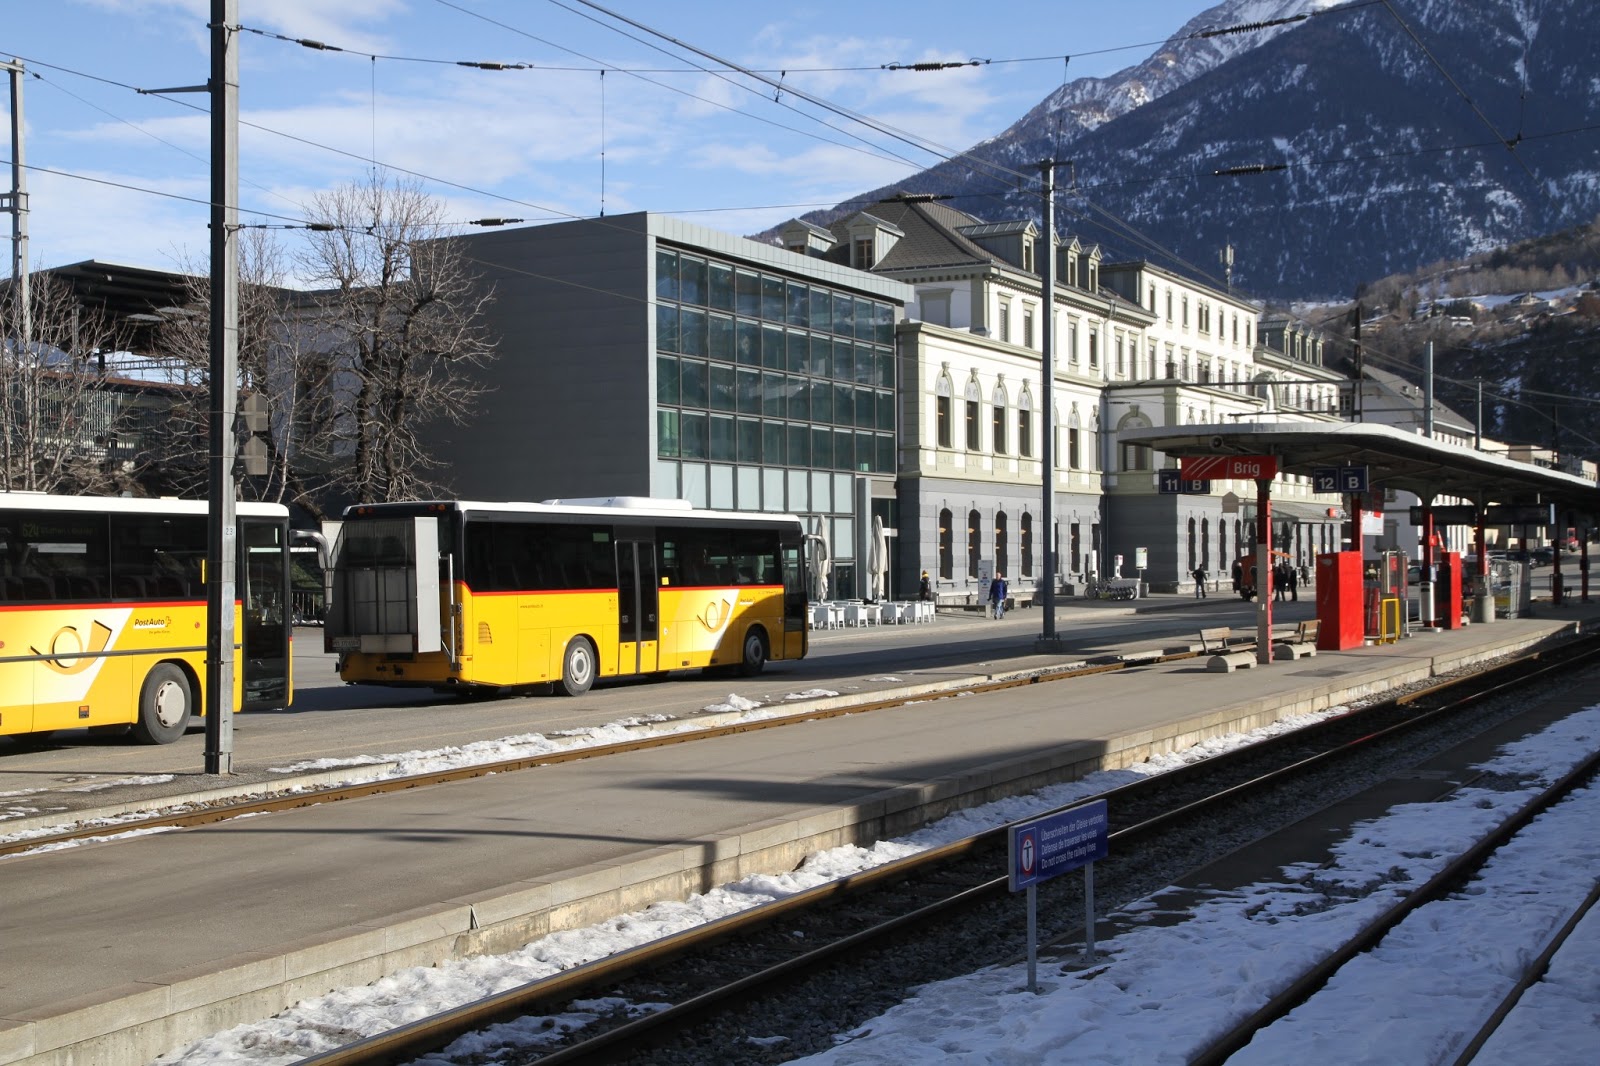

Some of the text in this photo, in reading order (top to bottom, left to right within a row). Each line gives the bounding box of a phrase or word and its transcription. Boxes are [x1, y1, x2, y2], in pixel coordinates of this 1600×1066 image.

[1234, 461, 1261, 476] Brig
[1165, 479, 1202, 491] 11 B
[1318, 476, 1360, 490] 12 B
[134, 618, 165, 627] PostAuto
[1076, 818, 1088, 829] Gleise
[1058, 839, 1064, 849] de
[1064, 835, 1081, 847] traverser
[1088, 829, 1097, 839] voies
[1041, 859, 1047, 869] Do
[1048, 856, 1056, 866] not
[1056, 853, 1066, 864] cross
[1074, 846, 1087, 857] railway
[1087, 843, 1096, 852] lines
